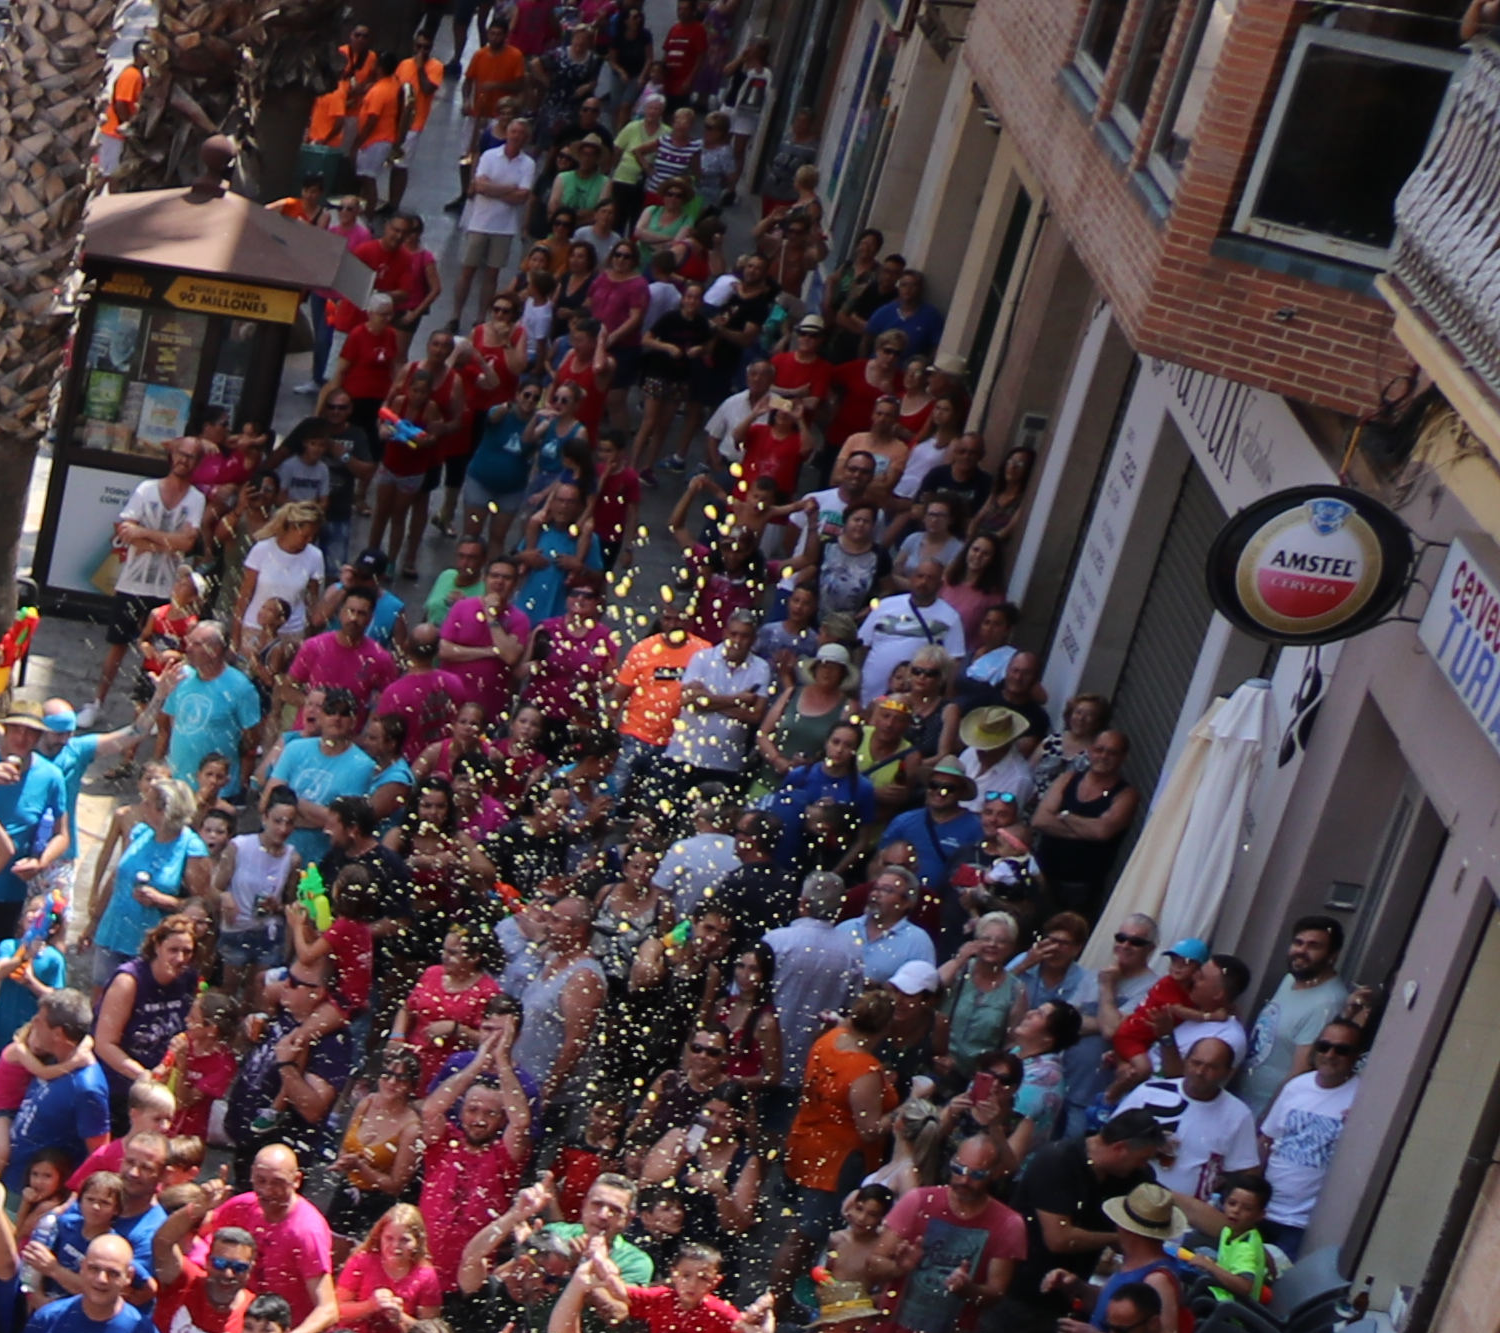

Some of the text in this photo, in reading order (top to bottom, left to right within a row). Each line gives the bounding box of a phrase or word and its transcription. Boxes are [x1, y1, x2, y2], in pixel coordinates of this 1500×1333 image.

[178, 292, 268, 314] 90 MILLONES
[1270, 549, 1357, 578] AMSTEL
[1271, 577, 1337, 595] CERVEZA
